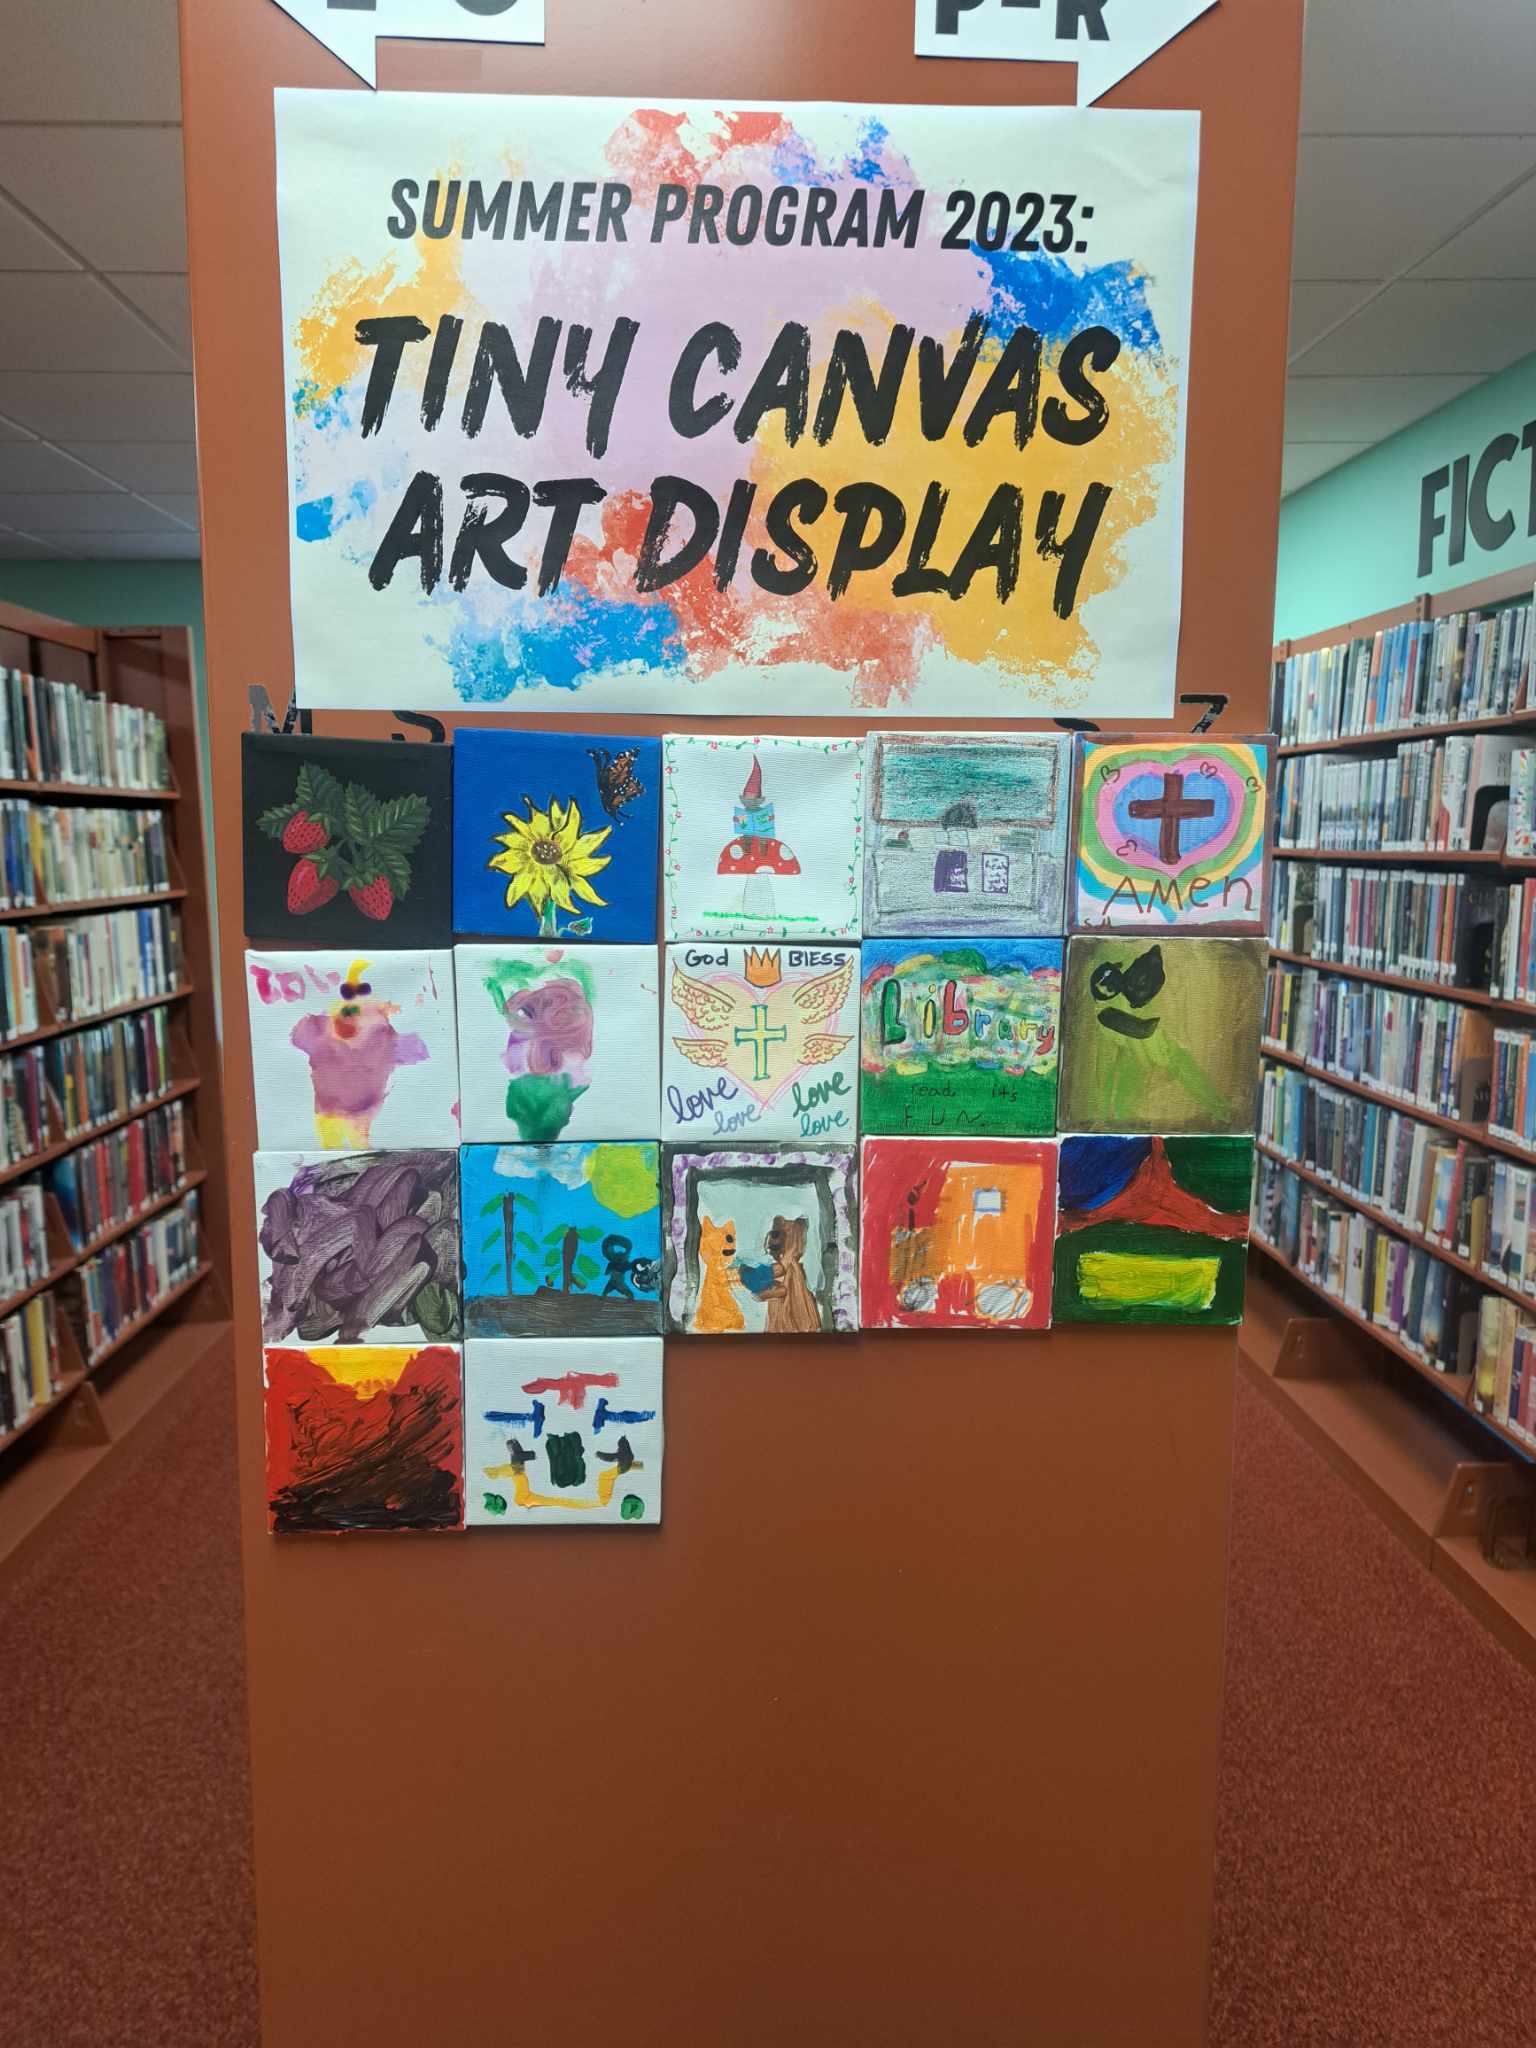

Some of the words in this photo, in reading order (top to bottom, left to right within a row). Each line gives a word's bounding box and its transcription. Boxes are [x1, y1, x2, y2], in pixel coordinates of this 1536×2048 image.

[387, 178, 632, 243] SUMMER
[650, 183, 925, 249] PROGRAM
[940, 190, 1094, 254] 2023:
[354, 314, 641, 460] TINY
[668, 311, 1121, 451] CANVAS
[368, 470, 607, 598] ART
[633, 475, 1113, 620] DISPLAY
[685, 948, 729, 967] God
[880, 978, 1056, 1057] Library
[666, 1076, 740, 1124] love
[791, 1071, 851, 1118] love
[712, 1103, 762, 1135] love
[799, 1110, 850, 1137] love
